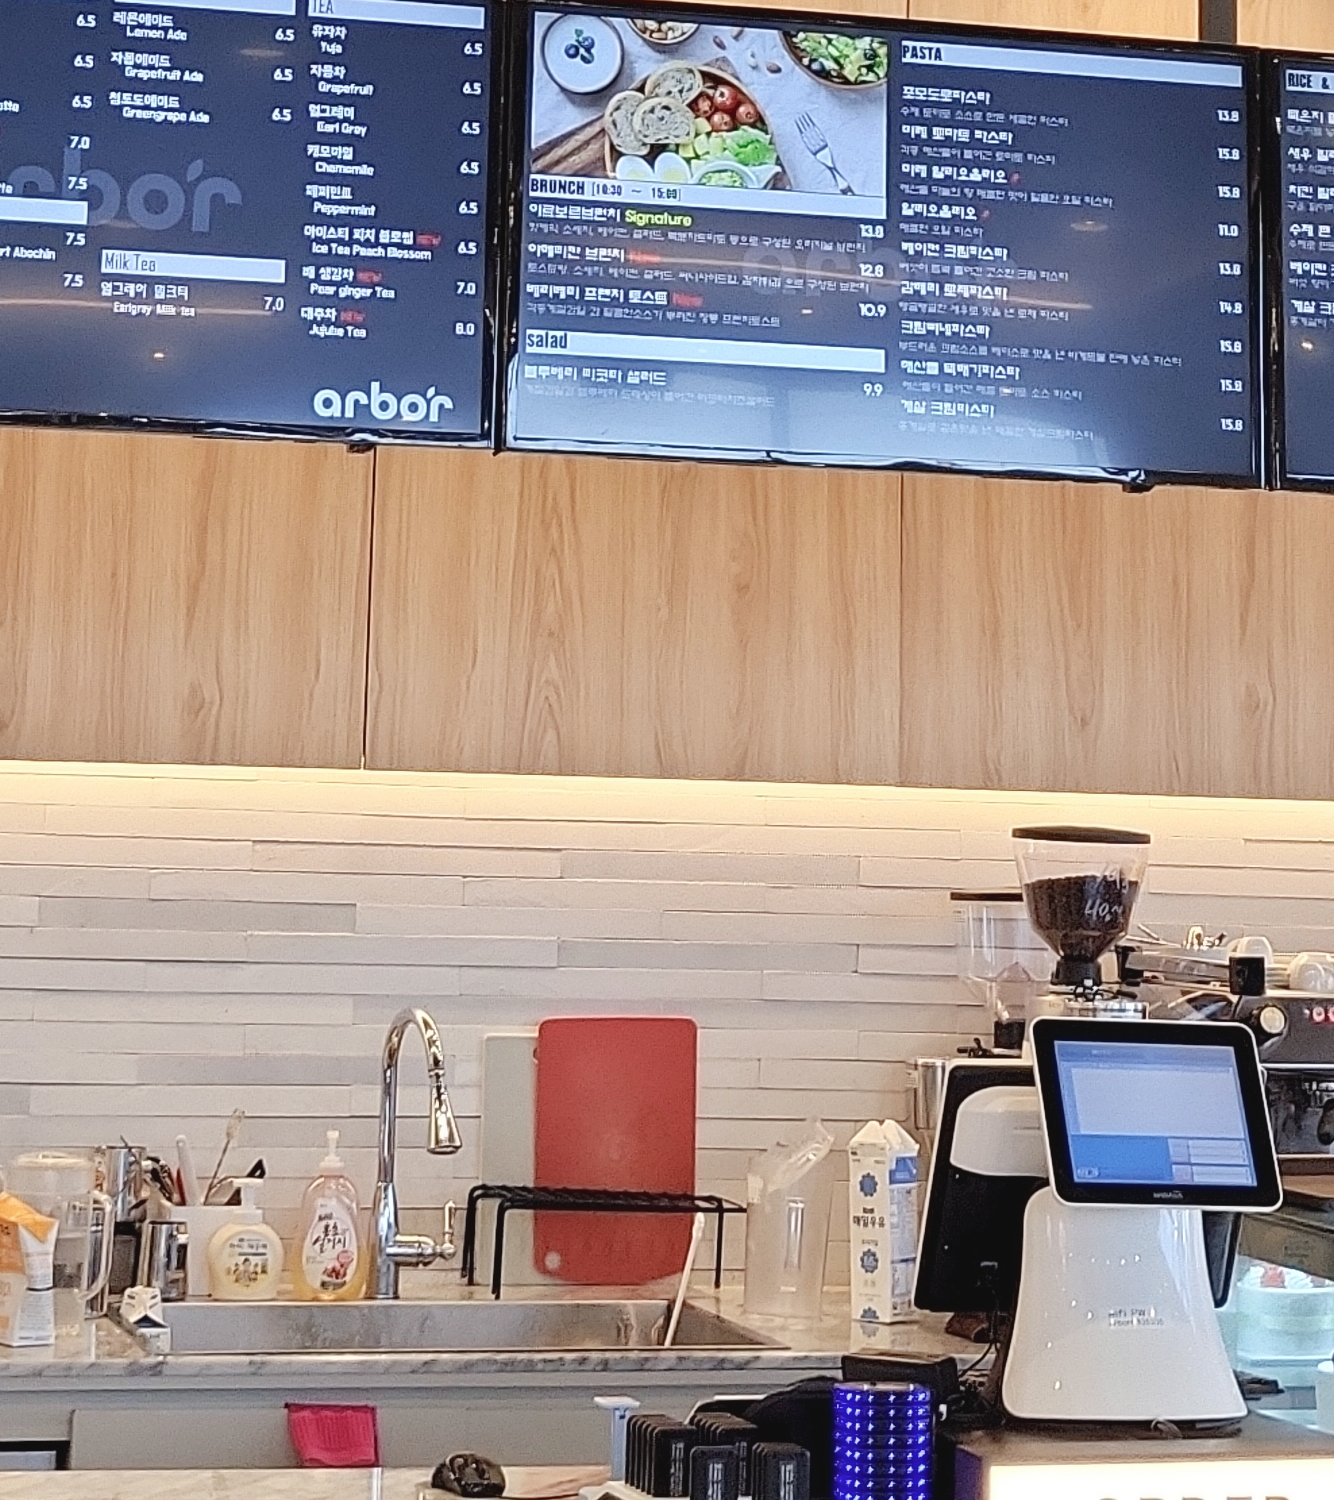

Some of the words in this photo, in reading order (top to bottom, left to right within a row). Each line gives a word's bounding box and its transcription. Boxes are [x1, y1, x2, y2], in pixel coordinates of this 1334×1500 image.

[77, 15, 96, 27] 6.5
[167, 29, 187, 40] Ade
[275, 29, 294, 41] 6.5
[464, 43, 482, 55] 6.5
[902, 46, 943, 61] PASTA
[74, 55, 93, 68] 6.5
[183, 70, 203, 82] Ade
[274, 69, 293, 81] 6.5
[1287, 73, 1312, 88] RICE
[1321, 77, 1329, 89] &
[463, 82, 481, 94] 6.5
[72, 96, 92, 108] 6.5
[189, 111, 209, 123] Ade
[272, 108, 291, 121] 6.5
[462, 122, 480, 134] 6.5
[460, 162, 479, 174] 6.5
[69, 177, 87, 189] 7.5
[531, 178, 585, 195] BRUNCH
[459, 201, 477, 214] 6.5
[625, 210, 691, 226] Signature
[66, 232, 85, 245] 7.5
[312, 242, 328, 253] Ice
[331, 243, 350, 255] Tea
[458, 242, 476, 254] 6.5
[104, 252, 130, 270] Milk
[133, 254, 156, 271] Tea
[859, 264, 883, 277] 12.8
[64, 274, 83, 287] 7.5
[375, 287, 394, 298] Tea
[457, 282, 475, 294] 7.0
[264, 297, 284, 311] 7.0
[859, 303, 886, 316] 10.9
[346, 326, 366, 337] Tea
[527, 332, 567, 348] salad
[864, 383, 883, 396] 9.9
